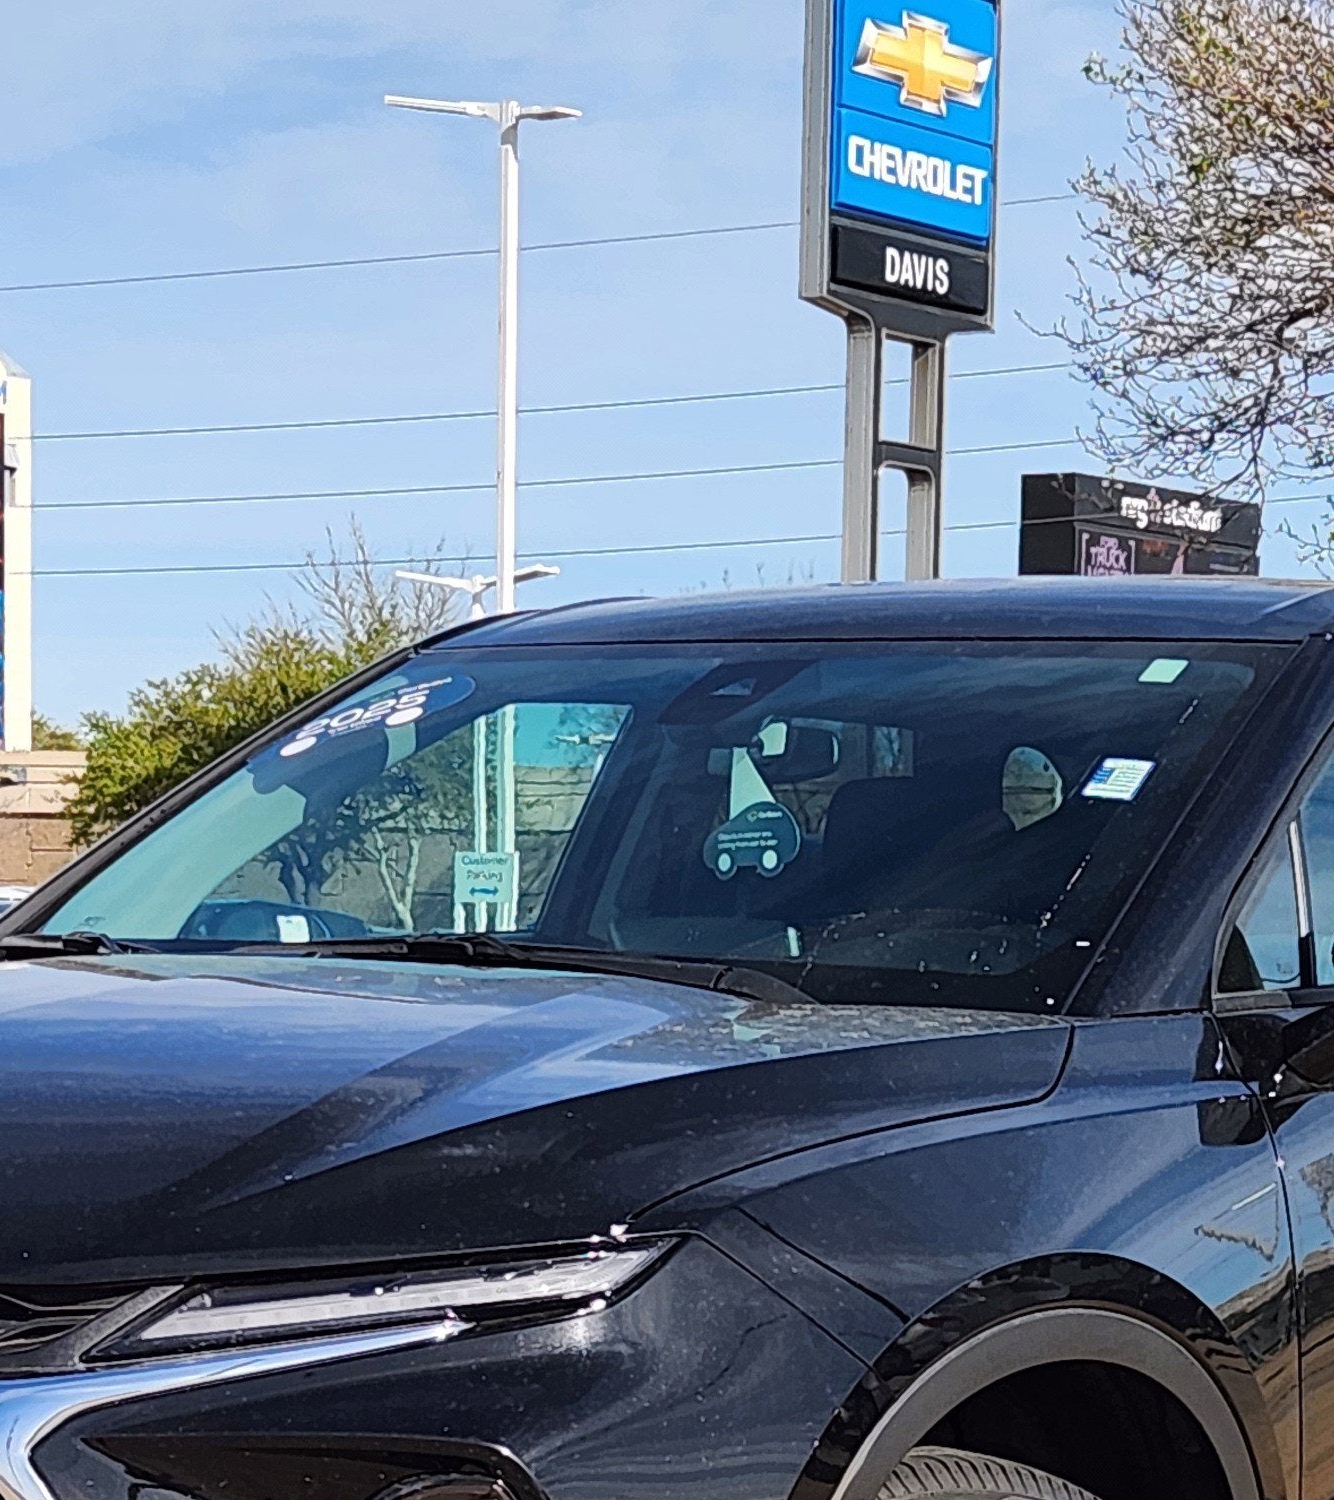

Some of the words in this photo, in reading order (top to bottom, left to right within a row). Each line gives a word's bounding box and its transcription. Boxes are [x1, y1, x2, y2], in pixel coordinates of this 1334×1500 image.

[848, 134, 988, 206] CHEVROLET
[884, 246, 950, 296] DAVIS
[295, 689, 430, 740] 2025
